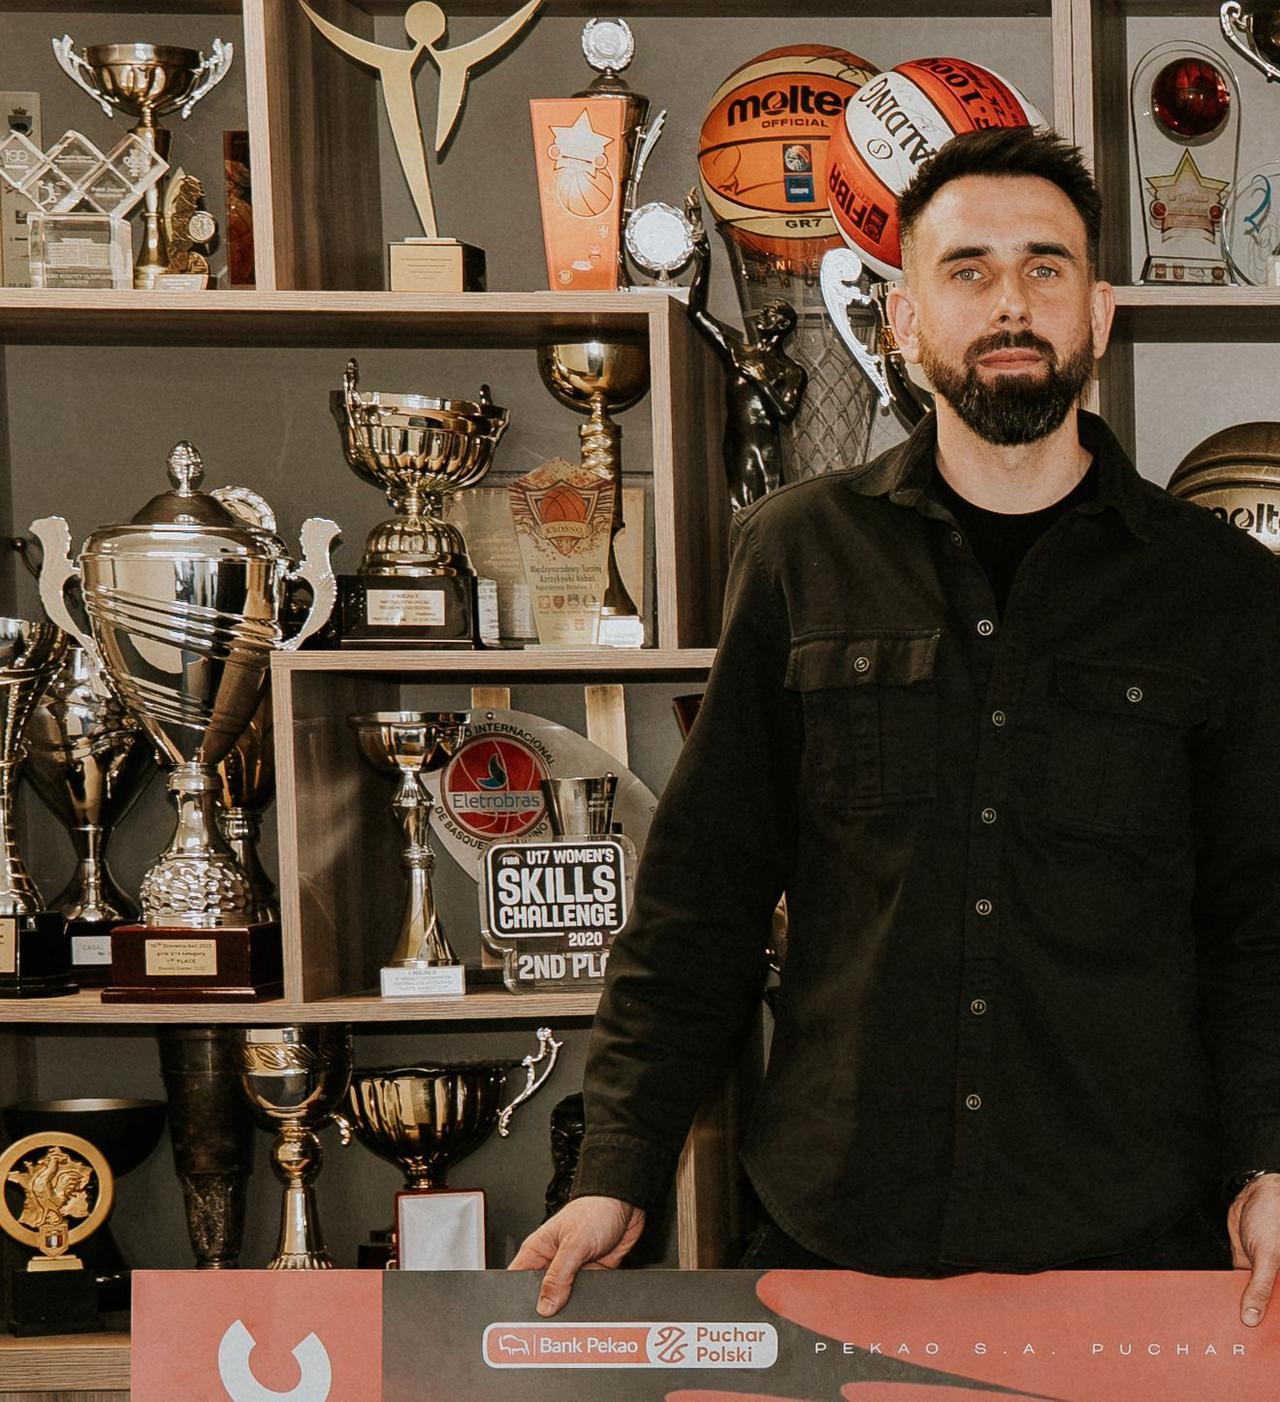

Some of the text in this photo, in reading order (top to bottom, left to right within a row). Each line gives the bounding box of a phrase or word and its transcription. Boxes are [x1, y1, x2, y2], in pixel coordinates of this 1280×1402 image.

[761, 118, 829, 129] OFFICIAL
[829, 163, 869, 231] FIBA
[785, 218, 822, 229] GR7
[474, 723, 556, 765] INTERNACIONAL
[453, 794, 540, 809] Eletrobras
[434, 806, 449, 821] DE
[444, 821, 488, 850] BASQUE
[502, 848, 614, 866] FIBA U17 WOMEN'S
[498, 865, 616, 906] SKILLS
[499, 903, 618, 929] CHALLENGE
[568, 931, 603, 947] 2020
[518, 954, 566, 980] 2ND
[696, 1326, 767, 1343] Puchar
[540, 1337, 639, 1354] Bank Pekao
[815, 1343, 939, 1355] PEKAO
[975, 1343, 1056, 1355] S.A.
[1092, 1343, 1245, 1356] PUCHAR
[696, 1346, 752, 1363] Polski
